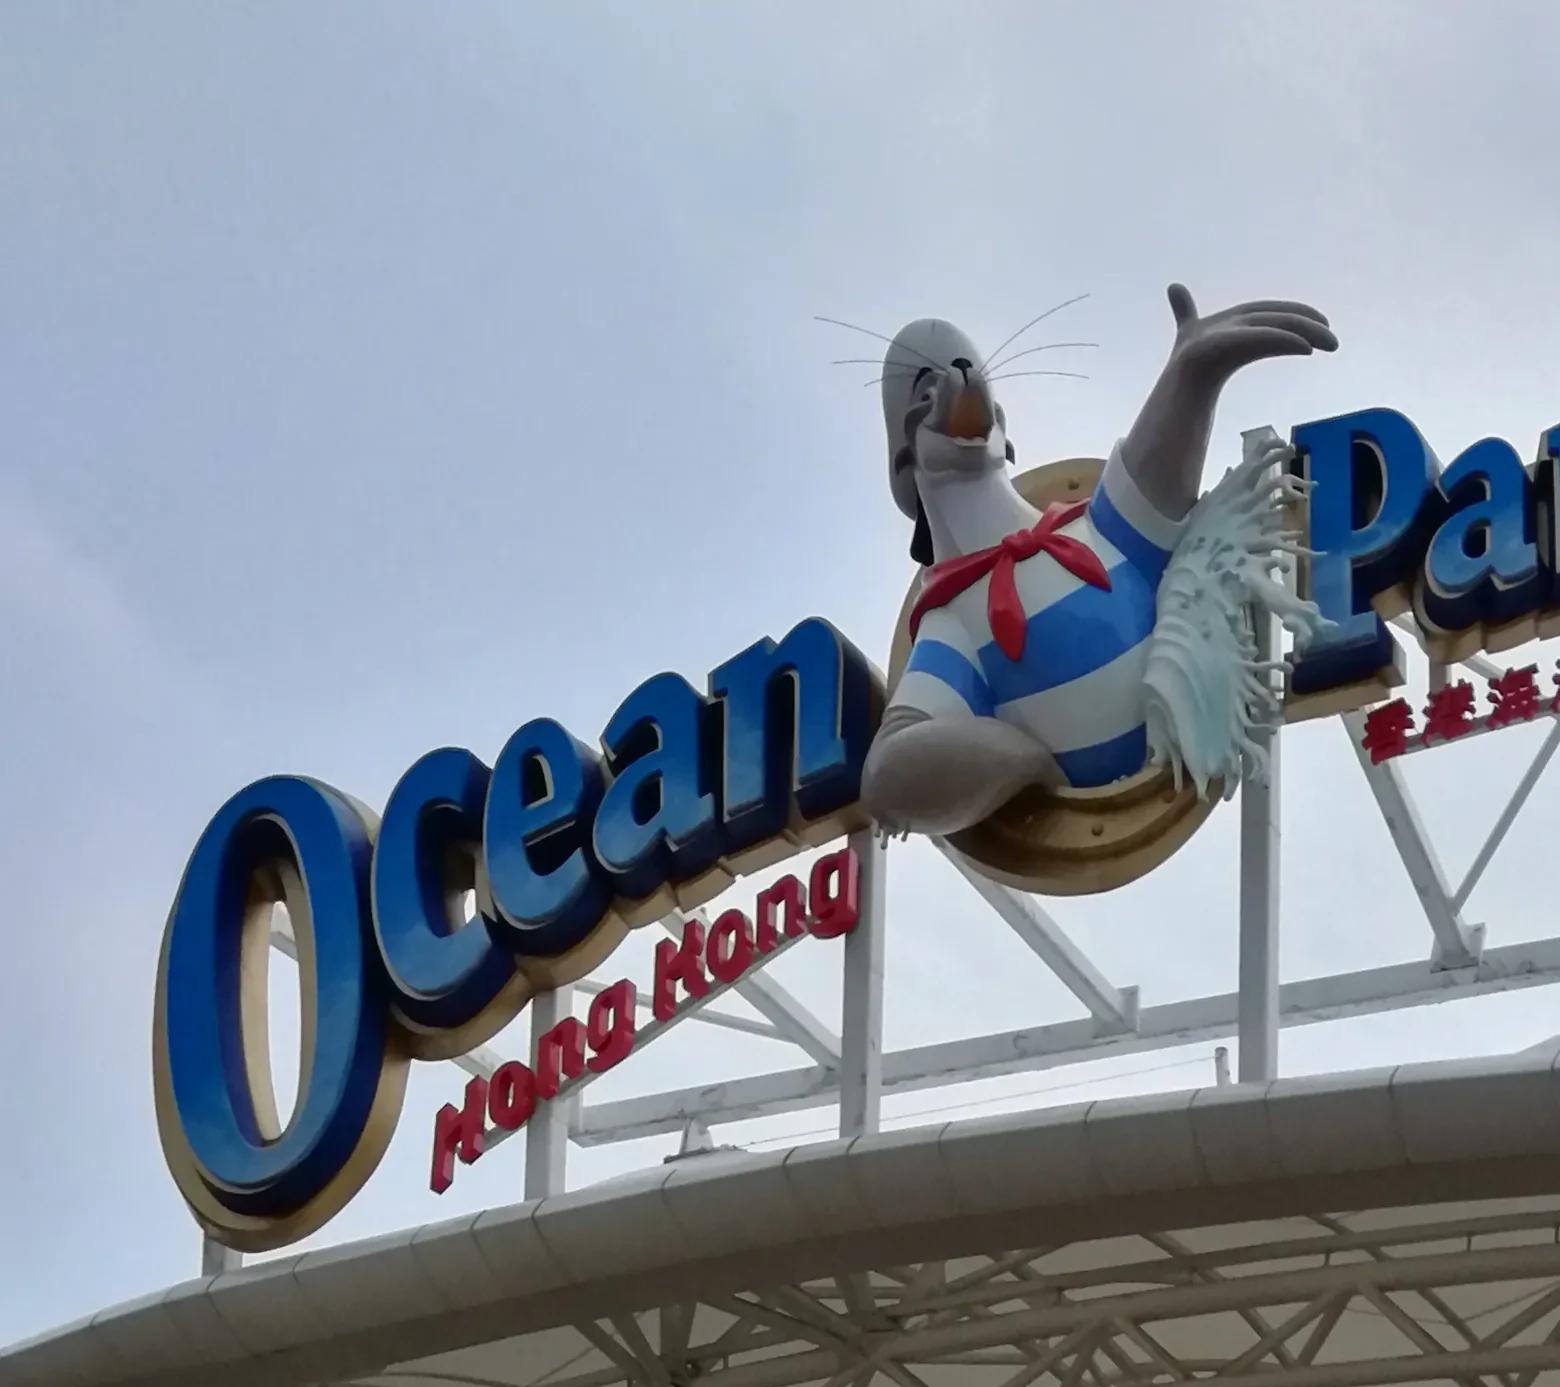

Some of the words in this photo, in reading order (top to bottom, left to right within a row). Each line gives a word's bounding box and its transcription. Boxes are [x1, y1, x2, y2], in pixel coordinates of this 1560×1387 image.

[156, 615, 890, 1245] Ocean
[430, 979, 637, 1195] Hong
[653, 847, 861, 1024] Kong
